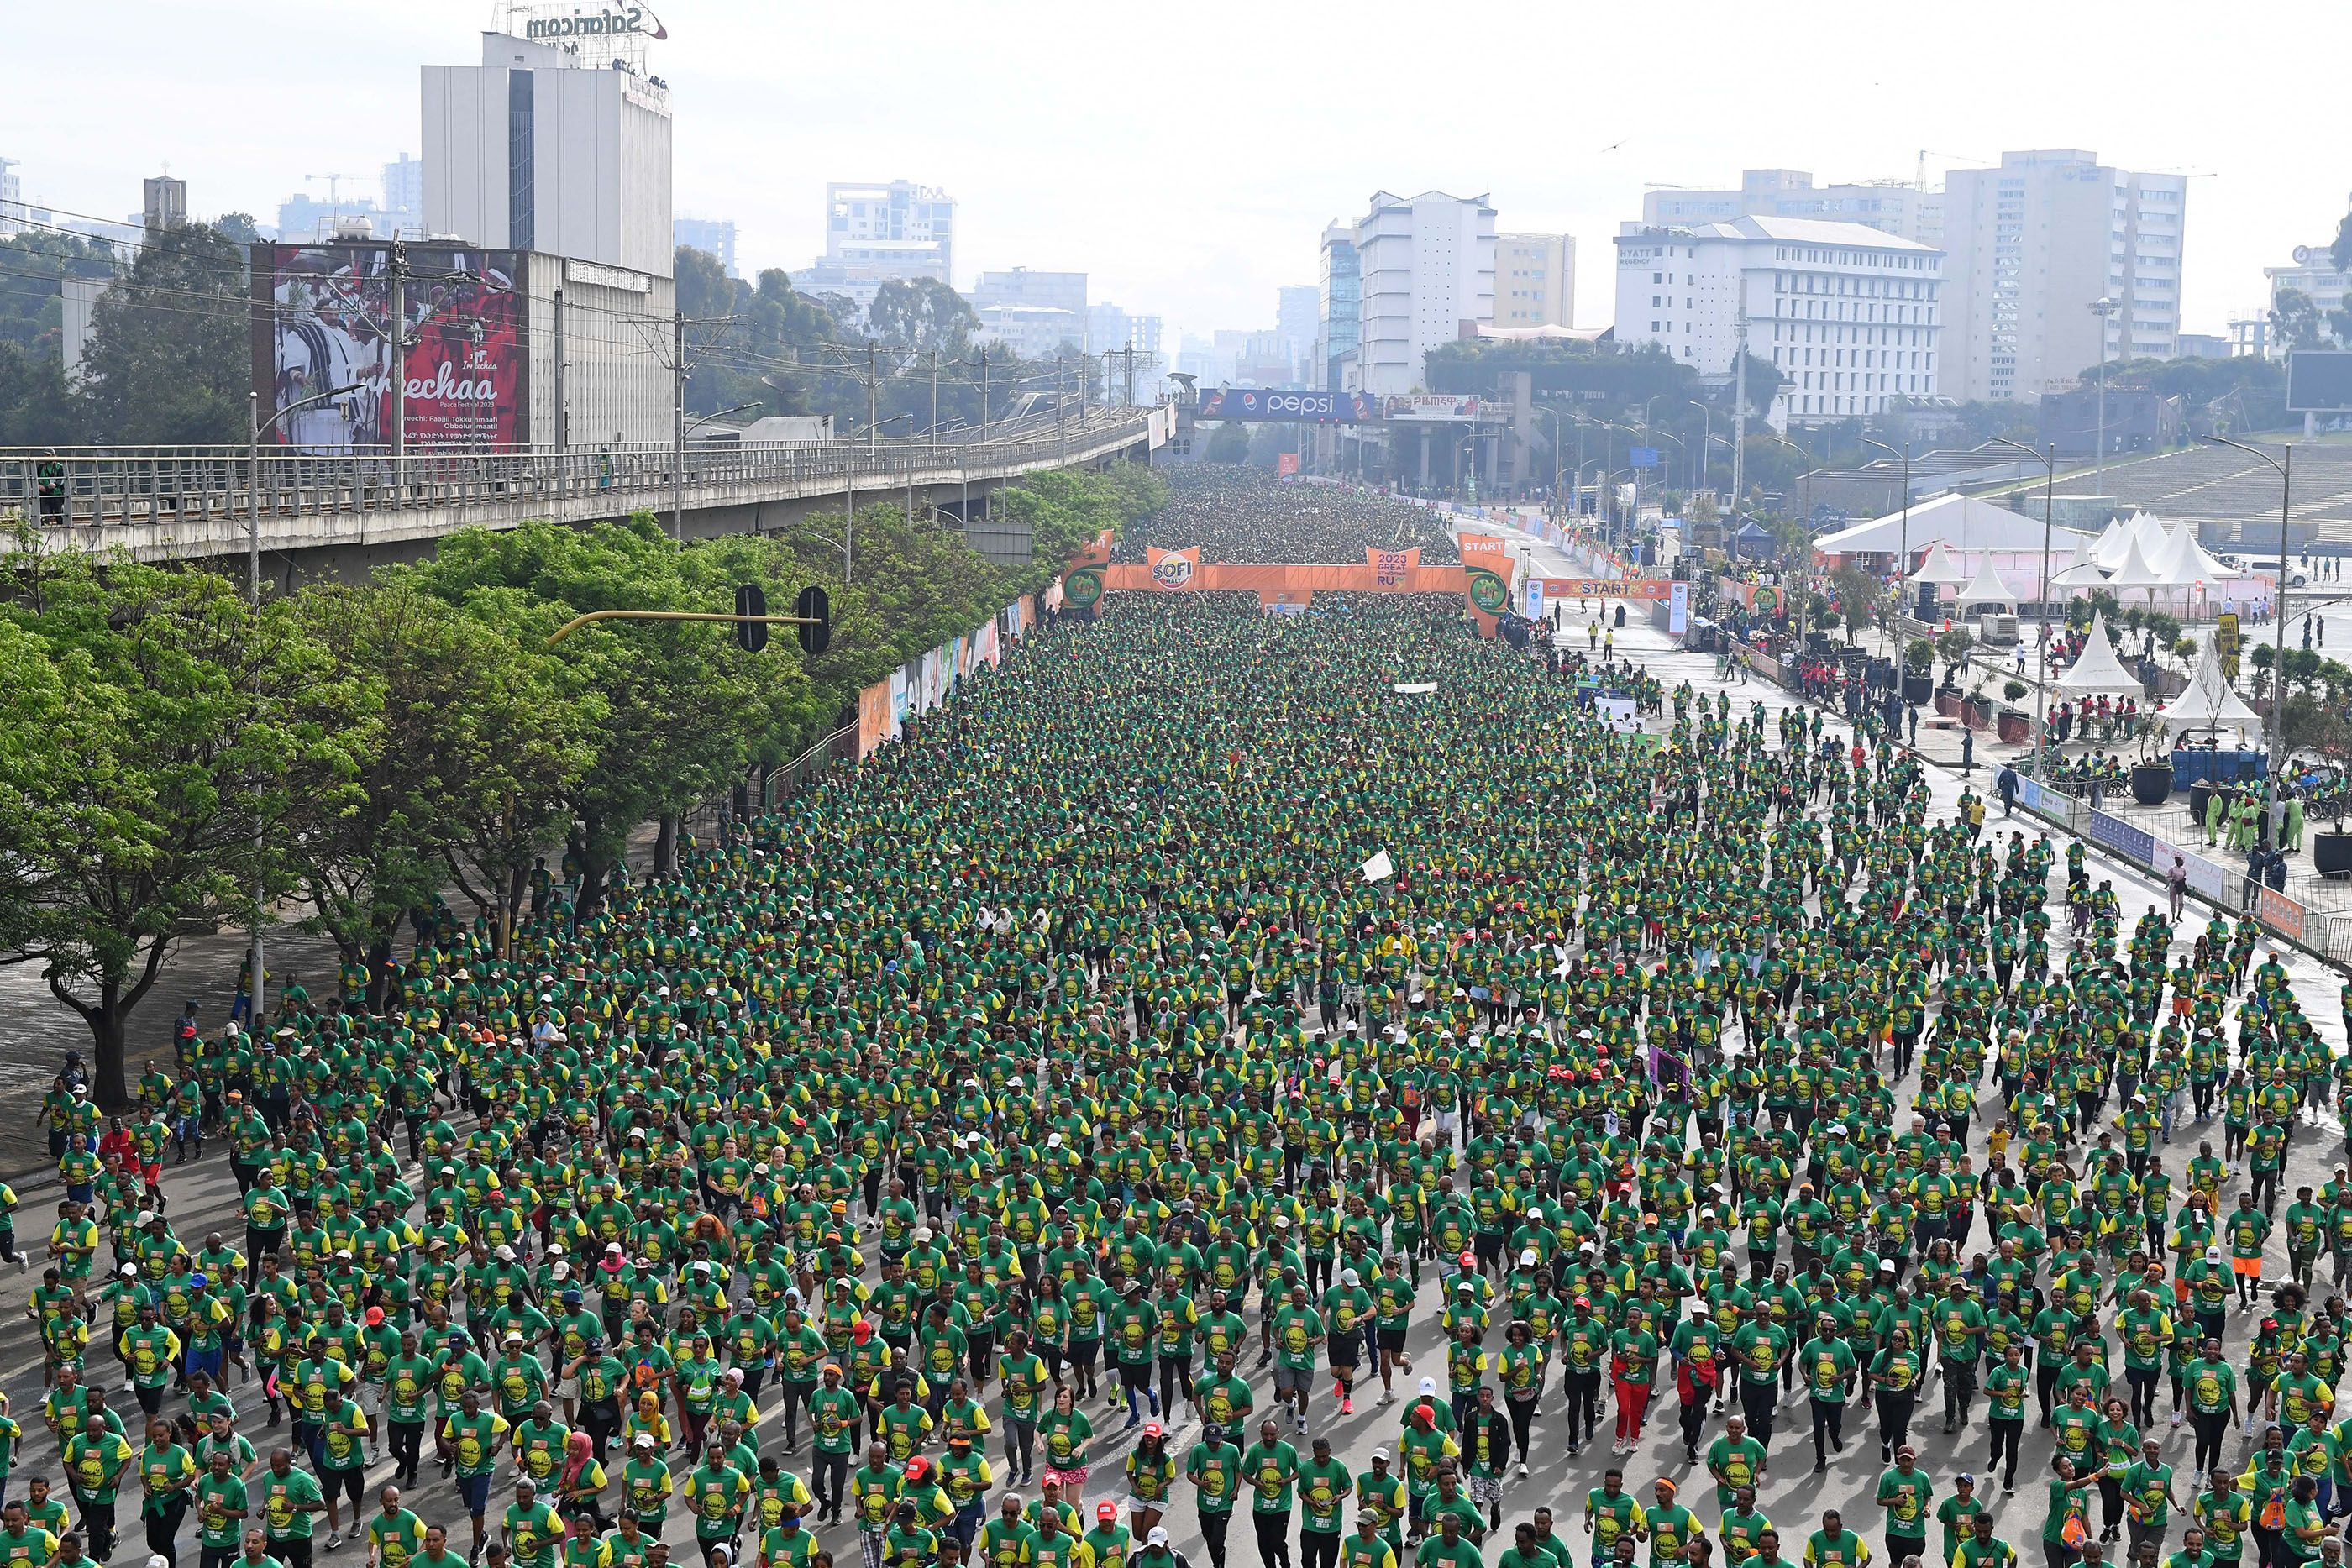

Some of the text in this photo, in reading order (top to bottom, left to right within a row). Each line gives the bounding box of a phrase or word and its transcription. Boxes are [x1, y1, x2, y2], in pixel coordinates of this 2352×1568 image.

[1620, 249, 1652, 257] HYATT
[1267, 394, 1334, 416] pepsi
[1464, 541, 1504, 551] START
[1378, 554, 1407, 564] 2023
[1152, 561, 1192, 579] SOFI
[1582, 583, 1631, 595] START
